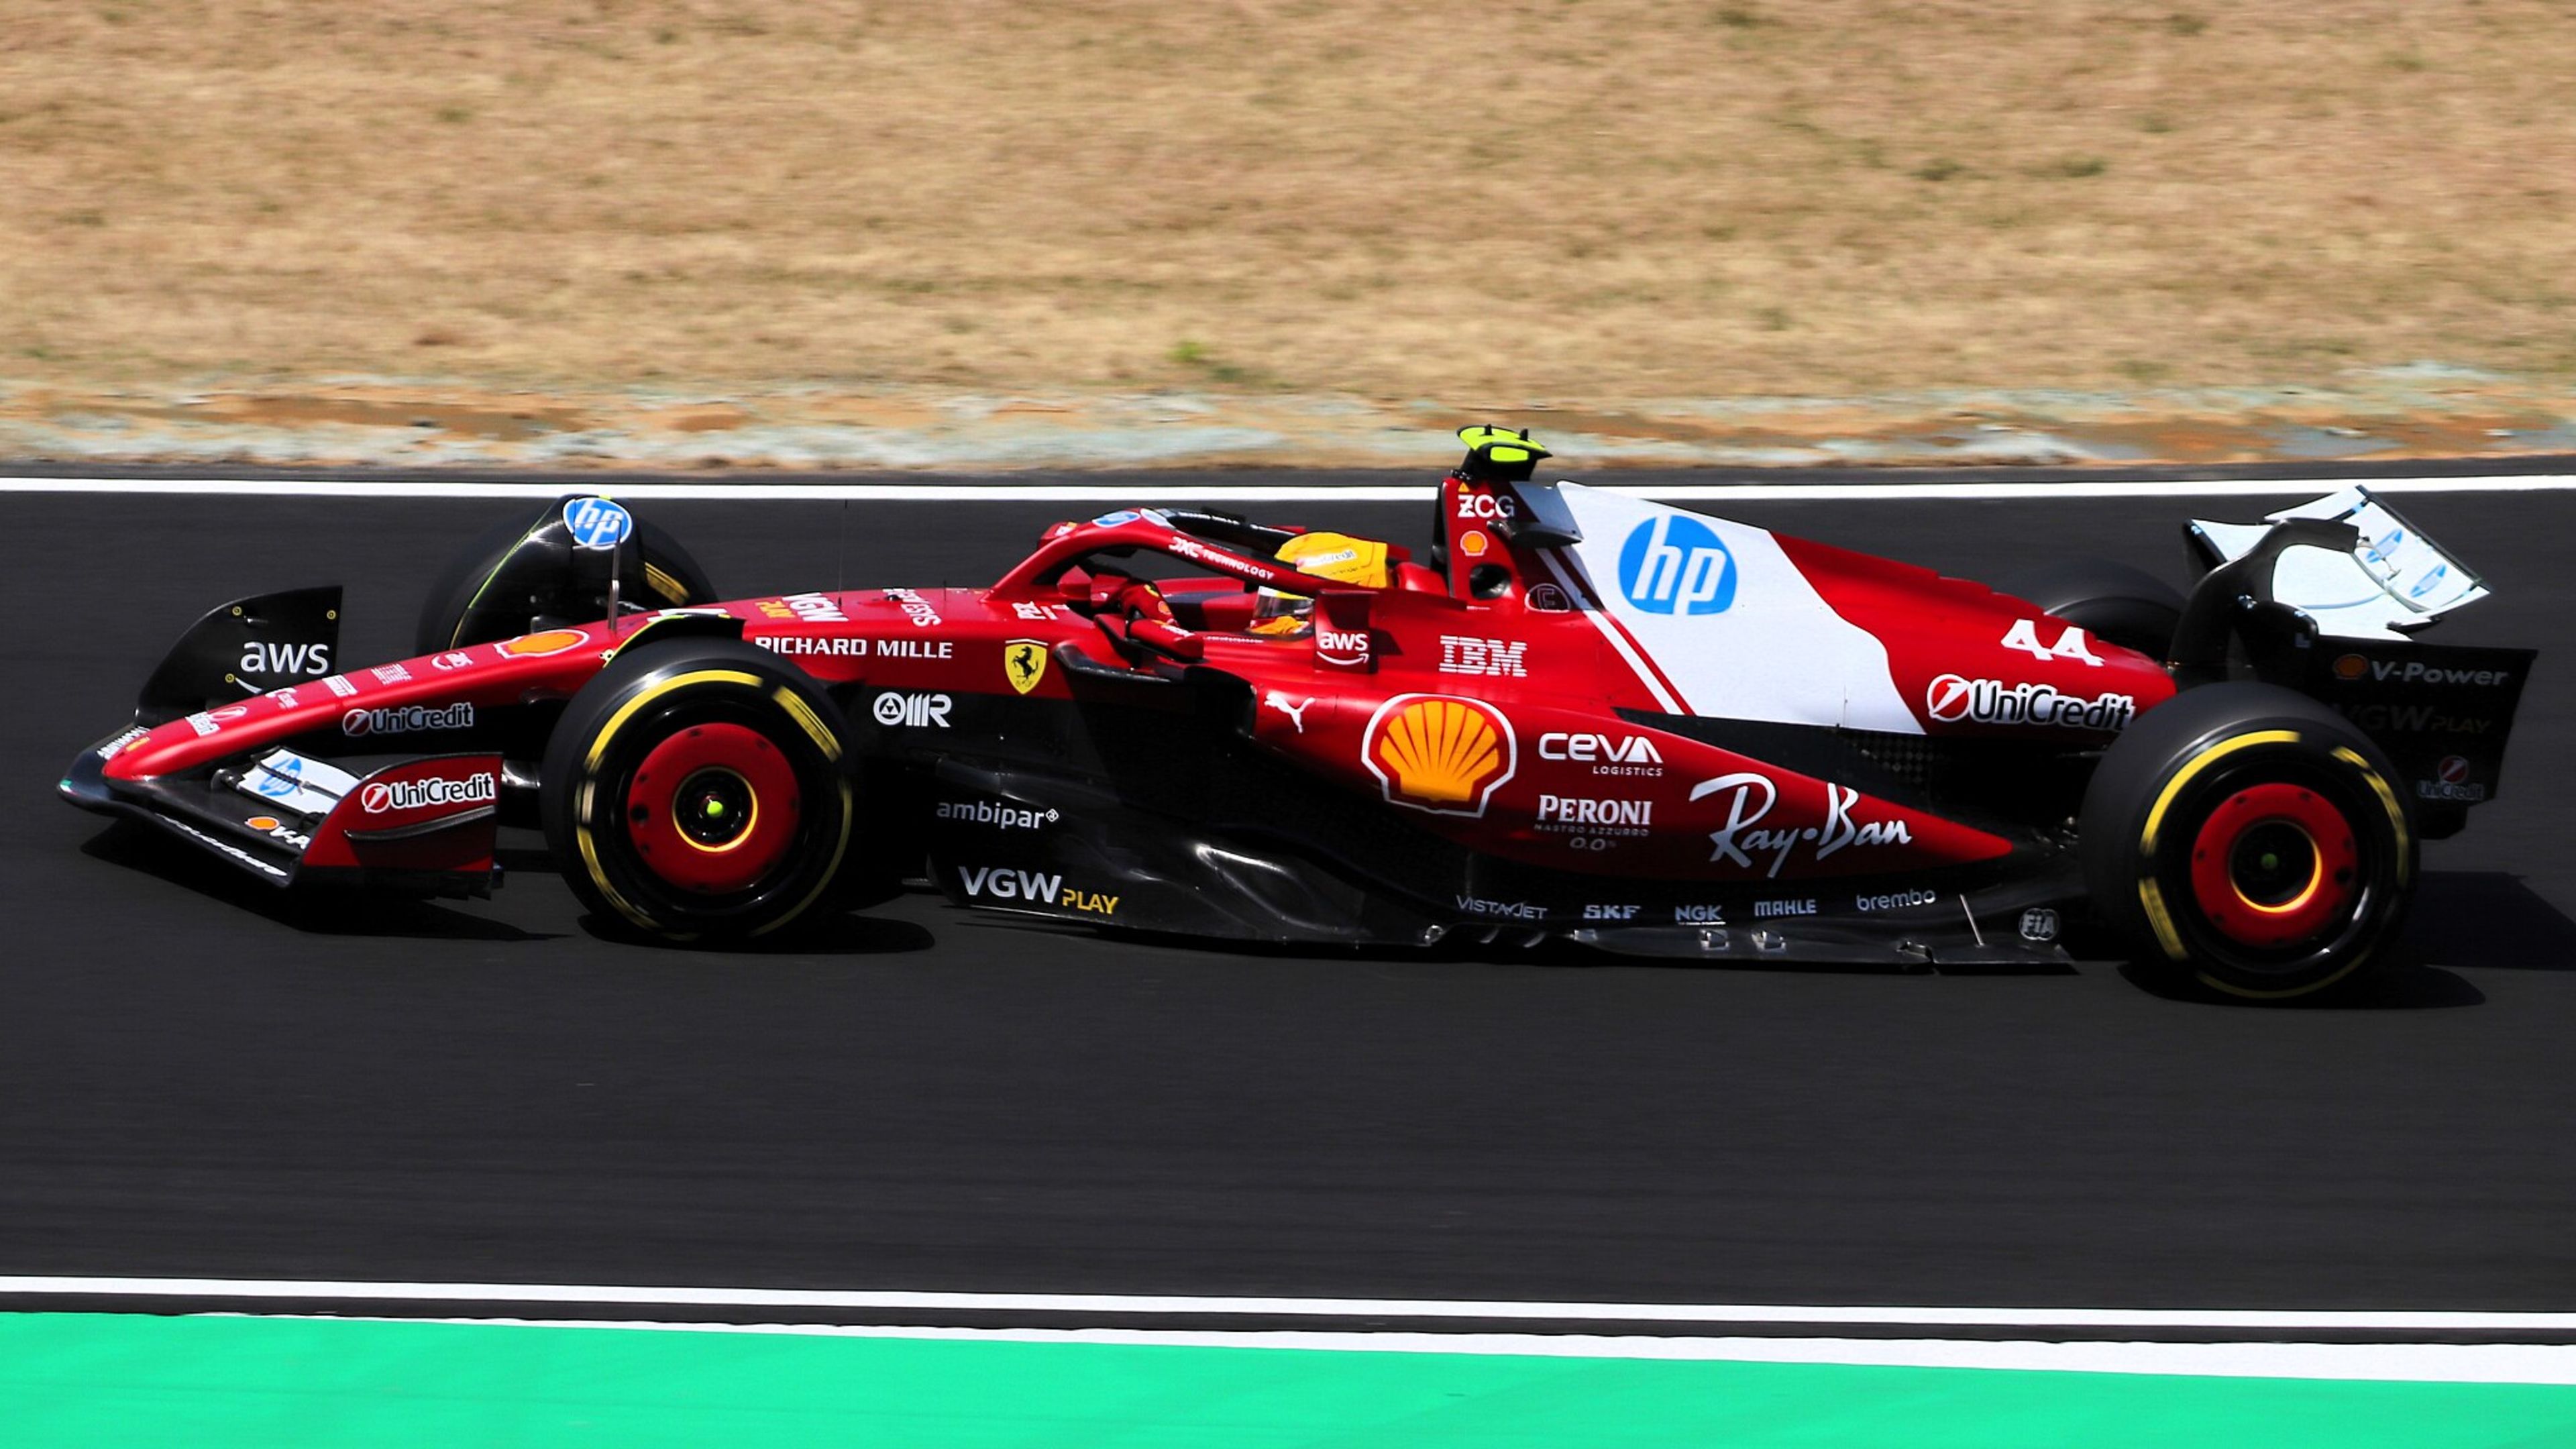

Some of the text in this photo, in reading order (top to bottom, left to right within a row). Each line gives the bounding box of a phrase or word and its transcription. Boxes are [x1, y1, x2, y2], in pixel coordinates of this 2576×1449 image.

[575, 498, 624, 545] hp
[1457, 494, 1515, 518] ZCG
[1203, 549, 1274, 580] TECHNOLOGY
[1631, 515, 1727, 615] hp
[755, 637, 953, 659] RICHARD MILLE
[1319, 632, 1368, 651] aws
[1439, 635, 1527, 678] IBM
[2000, 619, 2106, 667] 44
[240, 641, 329, 674] aws
[2371, 659, 2511, 686] V-Power
[372, 702, 474, 733] UniCredit
[1972, 679, 2135, 730] UniCredit
[1593, 765, 1663, 776] LOGISTICS
[388, 772, 494, 809] UniCredit
[936, 800, 1044, 830] ambipar
[1536, 794, 1652, 826] PERONI
[958, 865, 1120, 915] VGW PLAY
[1856, 888, 1937, 912] brembo
[1582, 905, 1641, 920] SKF
[1674, 905, 1723, 921] NGK
[1754, 899, 1817, 916] MAHLE
